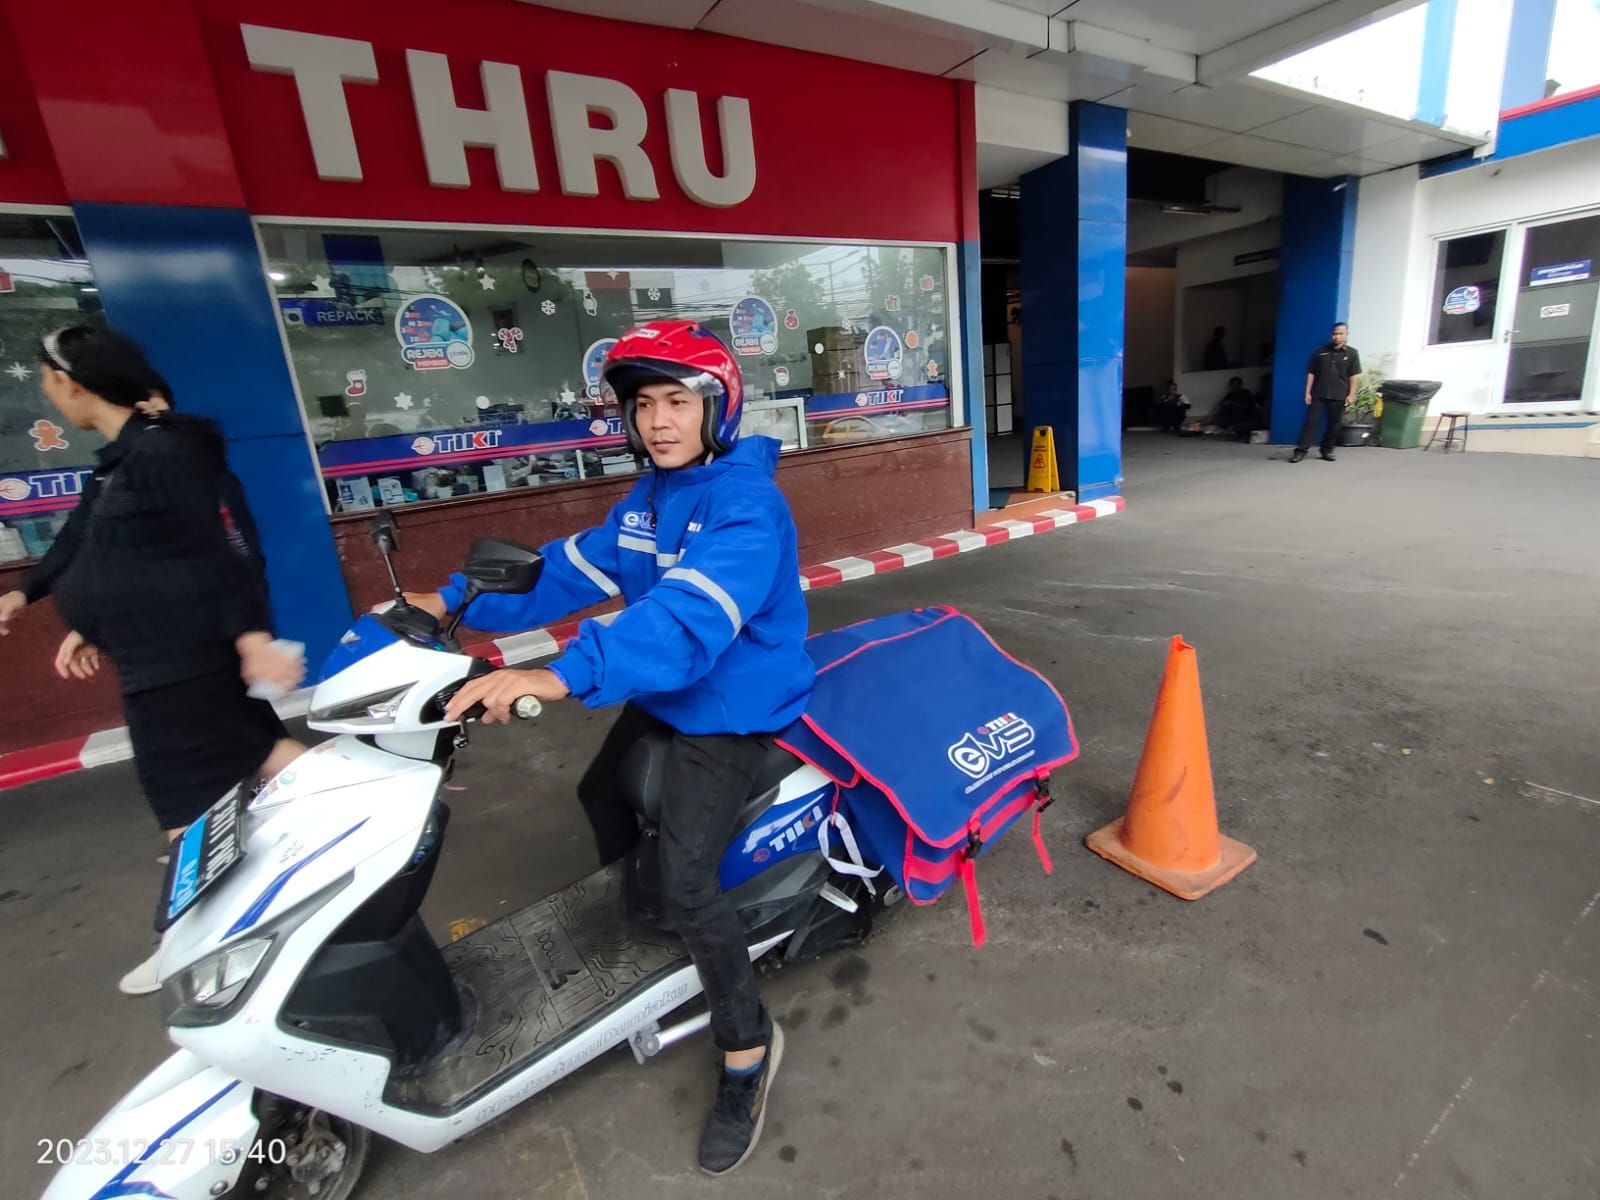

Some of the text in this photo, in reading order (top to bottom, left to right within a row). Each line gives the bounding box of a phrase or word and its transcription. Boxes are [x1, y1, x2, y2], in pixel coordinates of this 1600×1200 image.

[239, 23, 757, 208] THRU
[316, 310, 375, 323] REPACK
[406, 348, 444, 359] REJEKI
[433, 430, 499, 453] TIKI
[28, 470, 94, 497] TI
[769, 805, 823, 852] TIKI
